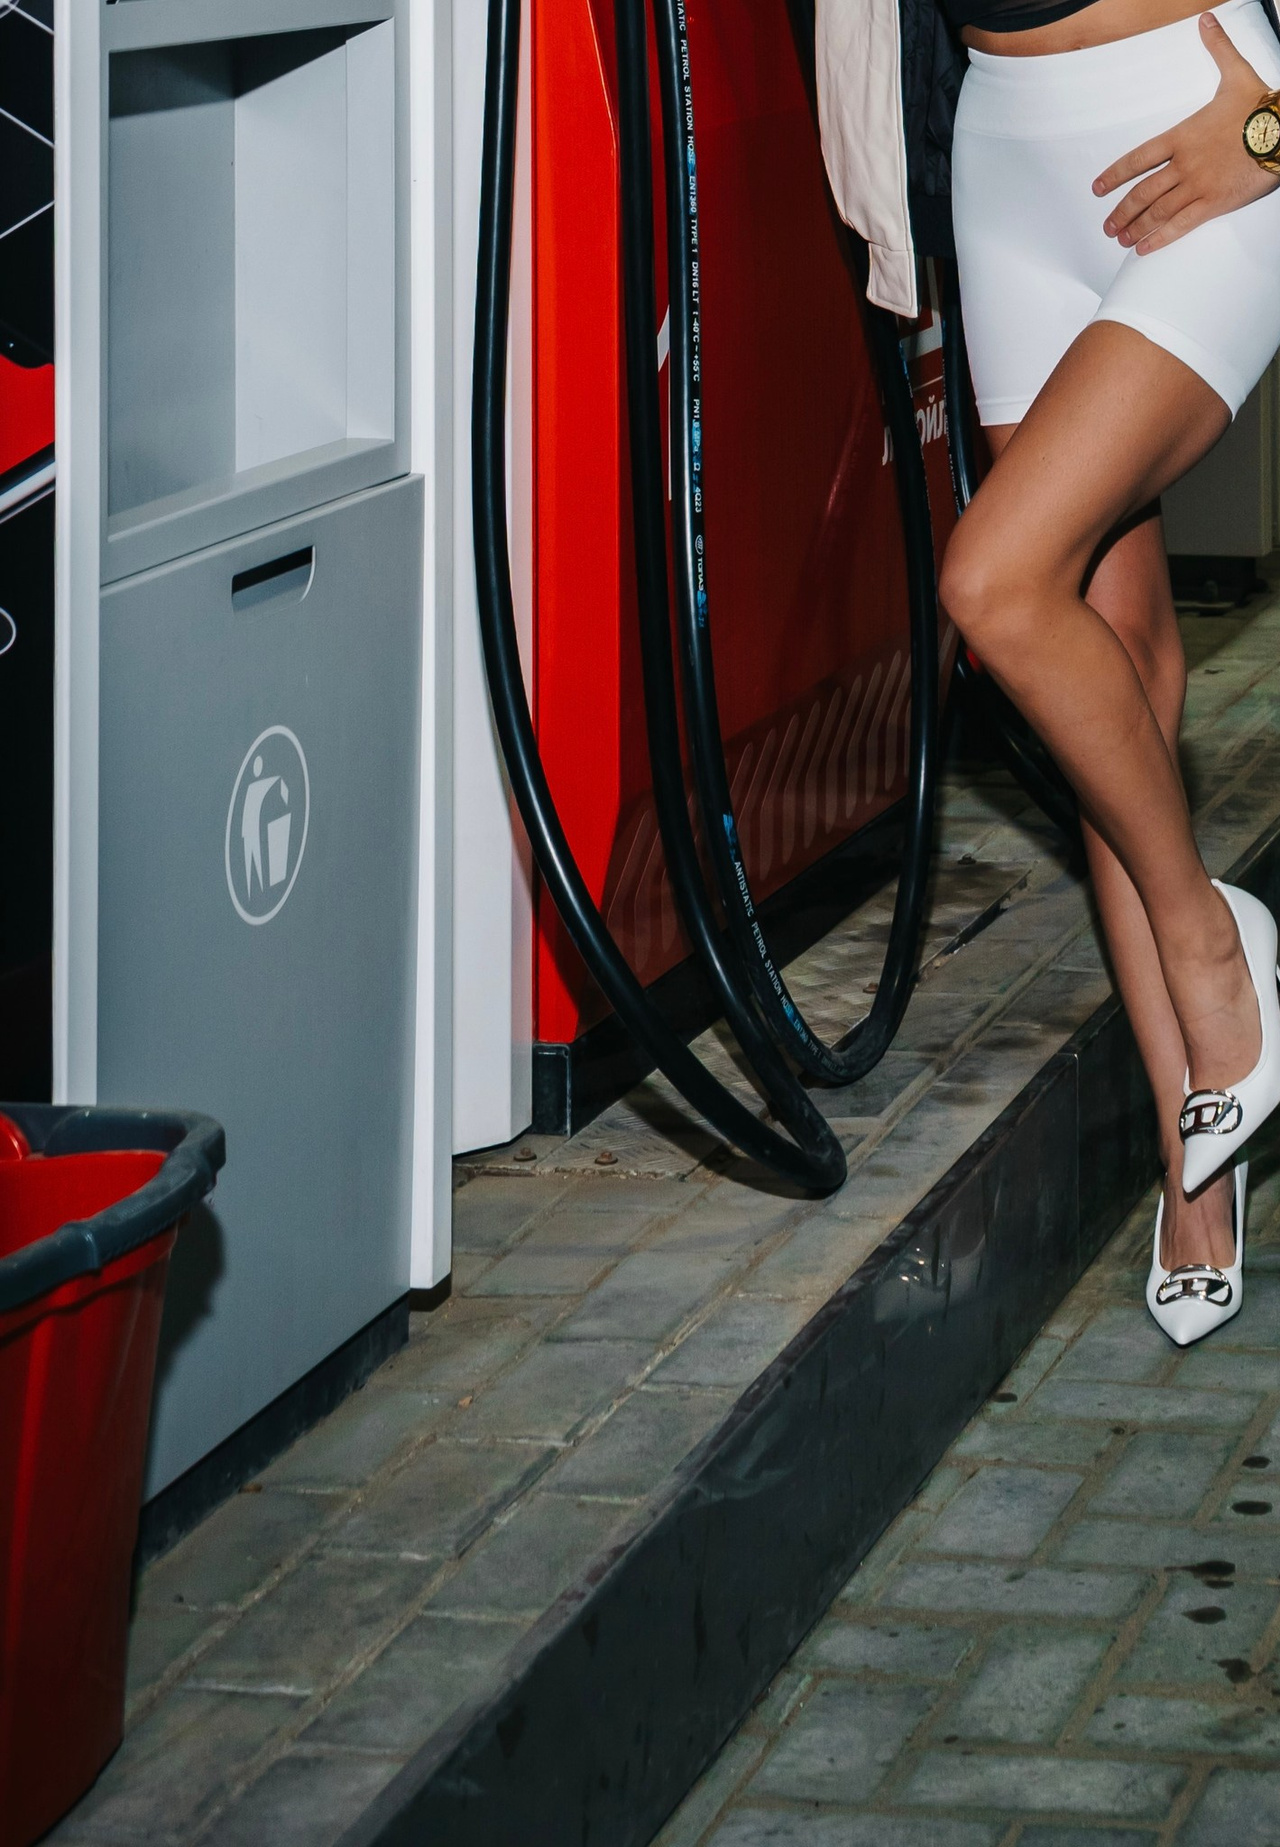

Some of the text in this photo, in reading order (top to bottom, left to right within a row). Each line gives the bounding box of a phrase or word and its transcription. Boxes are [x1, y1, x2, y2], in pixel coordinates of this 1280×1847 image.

[680, 39, 689, 81] PETROL
[684, 86, 693, 131] STATION
[687, 136, 695, 164] HOSE
[689, 175, 697, 213] EN1360
[734, 861, 755, 917] ANTISTATIC
[751, 921, 768, 959] PETROL
[765, 959, 782, 995] STATION
